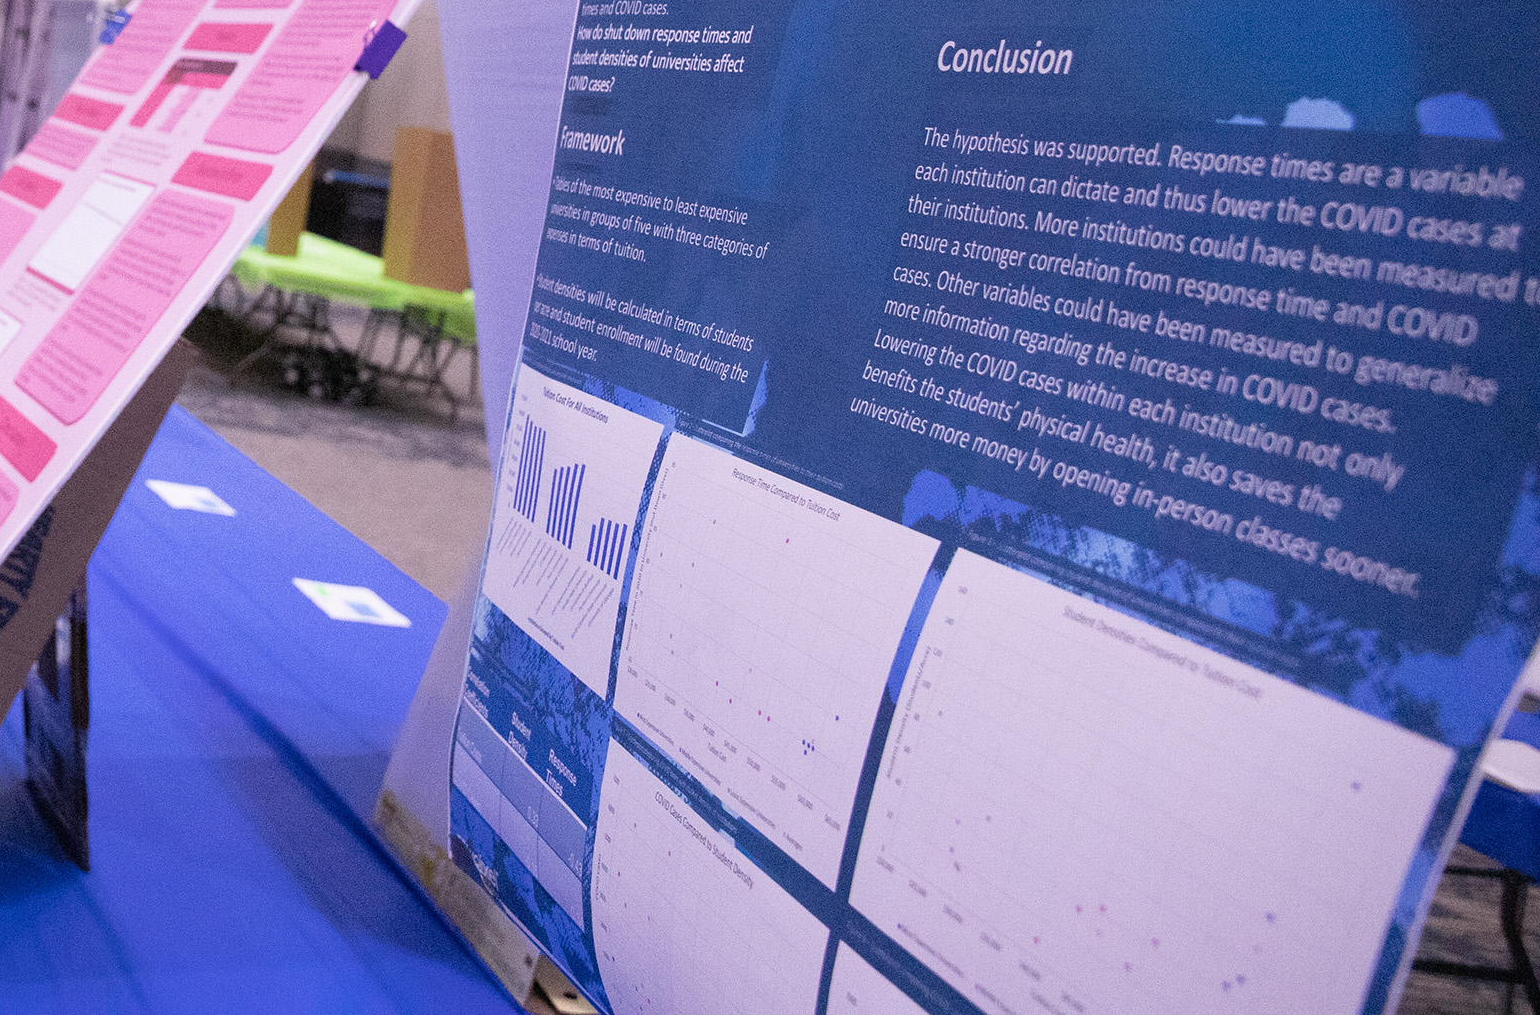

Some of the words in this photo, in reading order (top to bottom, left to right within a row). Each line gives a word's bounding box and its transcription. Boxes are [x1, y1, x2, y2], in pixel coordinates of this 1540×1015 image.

[936, 38, 1074, 75] Conclusion
[560, 124, 626, 155] Framework
[923, 125, 950, 149] The
[951, 127, 1030, 156] hypothesis
[1032, 139, 1065, 159] was
[1066, 141, 1162, 167] supported.
[1166, 143, 1266, 176] Response
[1269, 151, 1335, 182] times
[1337, 161, 1383, 187] are
[1384, 166, 1404, 189] a
[569, 177, 580, 193] of
[577, 179, 592, 196] the
[591, 184, 615, 200] most
[614, 188, 662, 210] expensive
[661, 195, 674, 212] to
[673, 195, 699, 217] least
[697, 203, 749, 226] expensive
[882, 298, 921, 321] more
[920, 302, 1010, 342] information
[1011, 327, 1093, 367] regarding
[1094, 340, 1127, 370] the
[1128, 347, 1214, 390] increase
[1215, 366, 1239, 395] in
[1241, 372, 1319, 414] COVID
[1319, 396, 1397, 434] cases.
[860, 358, 918, 394] benefits
[918, 376, 945, 402] the
[944, 386, 1021, 422] students’
[1016, 405, 1091, 444] physical
[1089, 422, 1157, 469] health,
[1161, 443, 1182, 473] it
[1180, 451, 1228, 486] also
[1228, 469, 1294, 506] saves
[1296, 484, 1343, 520] the
[731, 466, 757, 486] Response
[757, 476, 771, 492] Time
[769, 483, 800, 504] Compared
[797, 496, 807, 507] to
[806, 497, 827, 516] Tuition
[824, 506, 841, 522] Cost
[548, 749, 577, 787] Response
